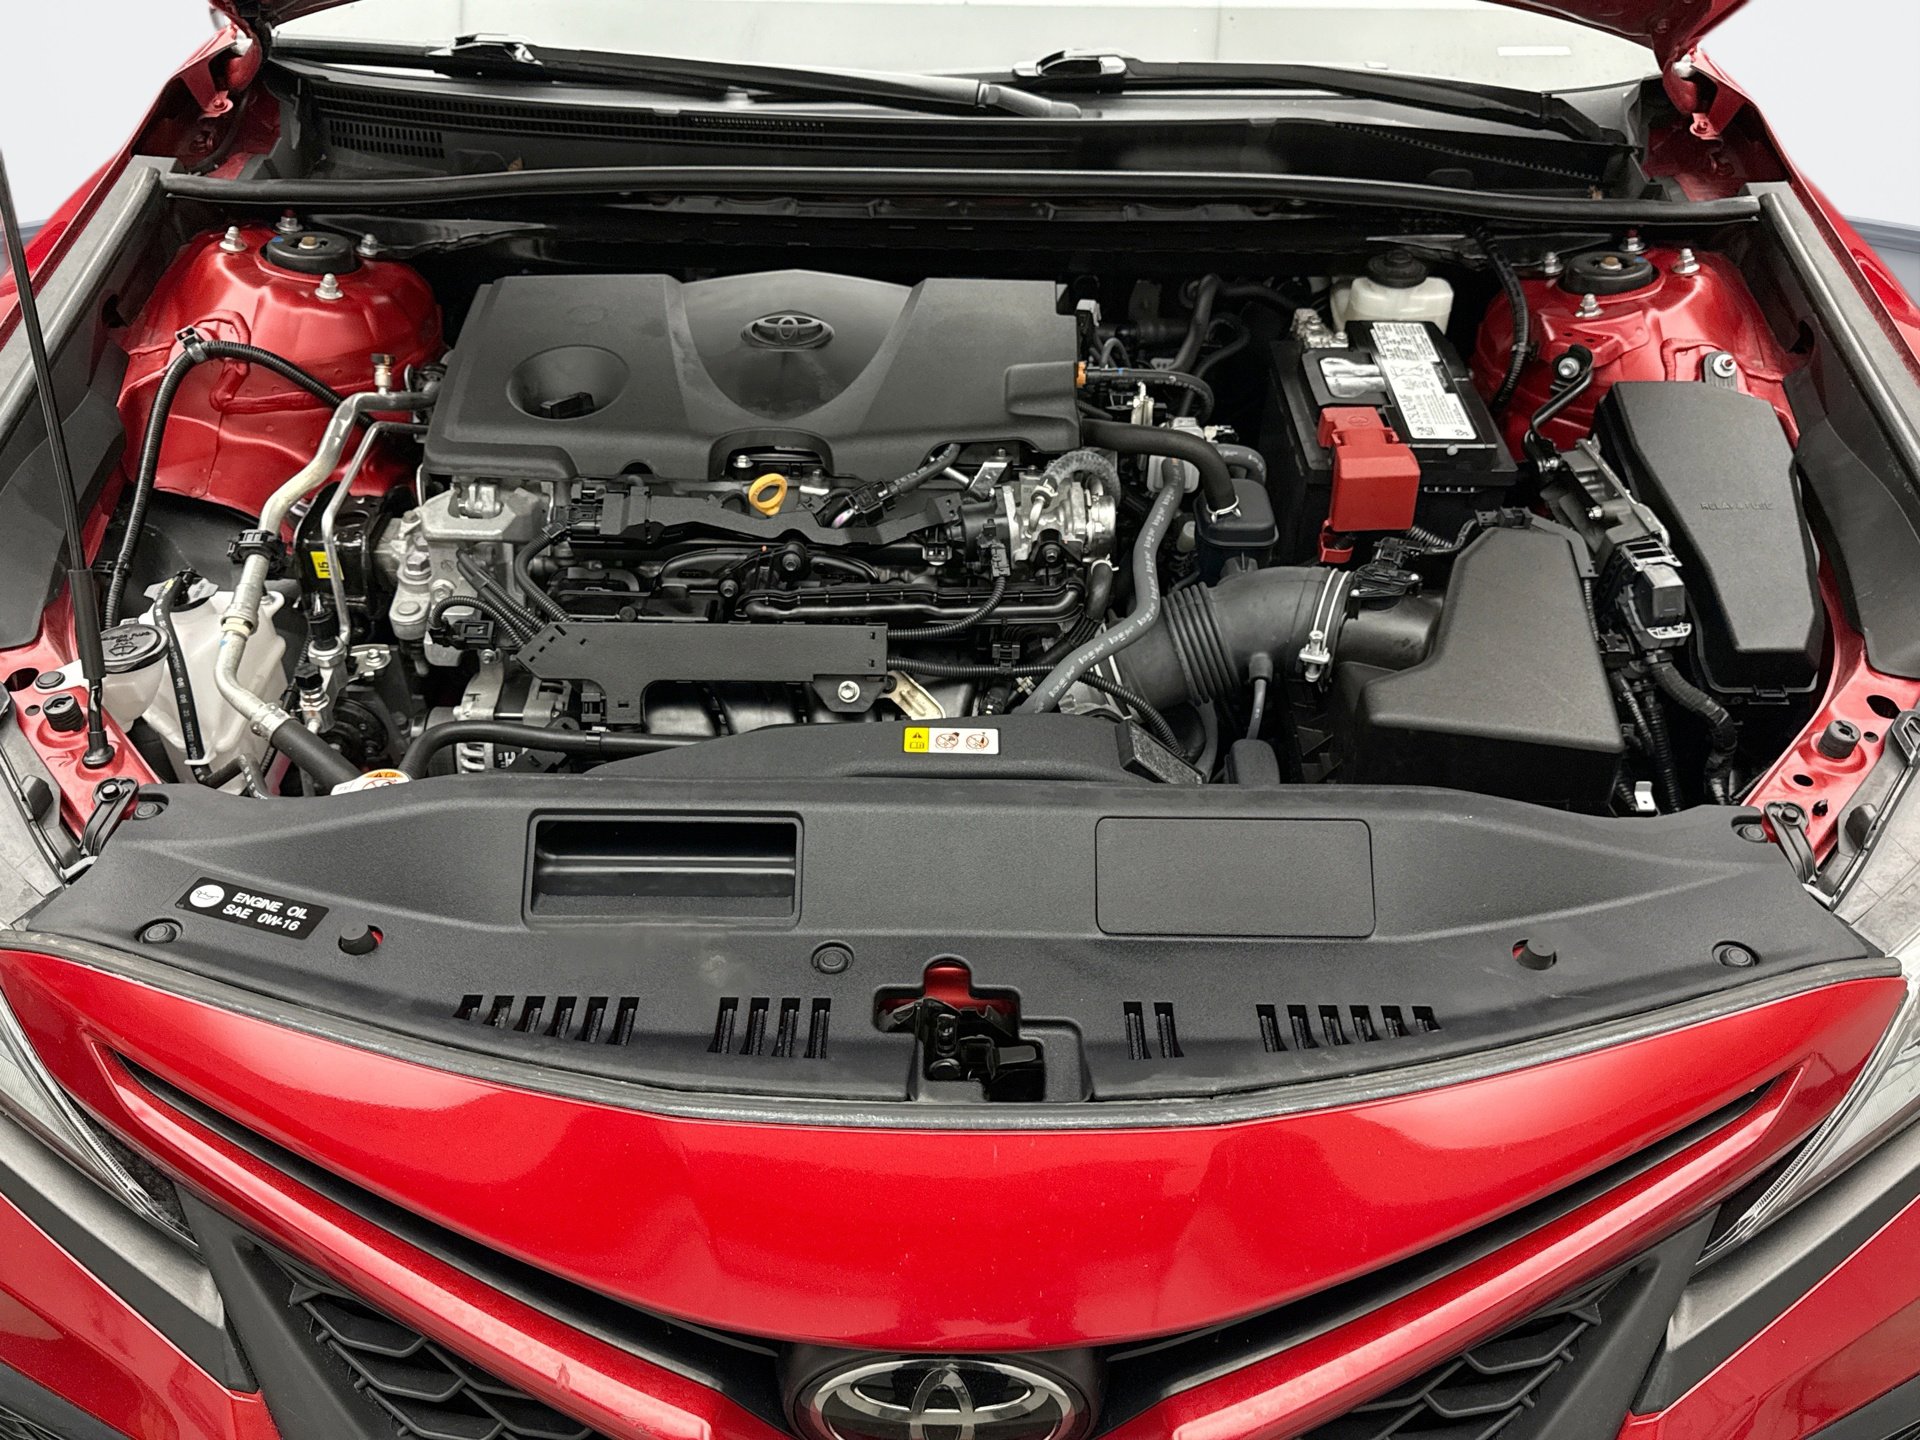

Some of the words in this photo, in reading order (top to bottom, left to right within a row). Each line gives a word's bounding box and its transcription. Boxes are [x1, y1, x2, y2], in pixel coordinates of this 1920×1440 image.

[222, 903, 254, 919] SAE
[256, 912, 301, 931] 0W-16
[232, 892, 284, 913] ENGINE
[286, 905, 308, 920] OIL
